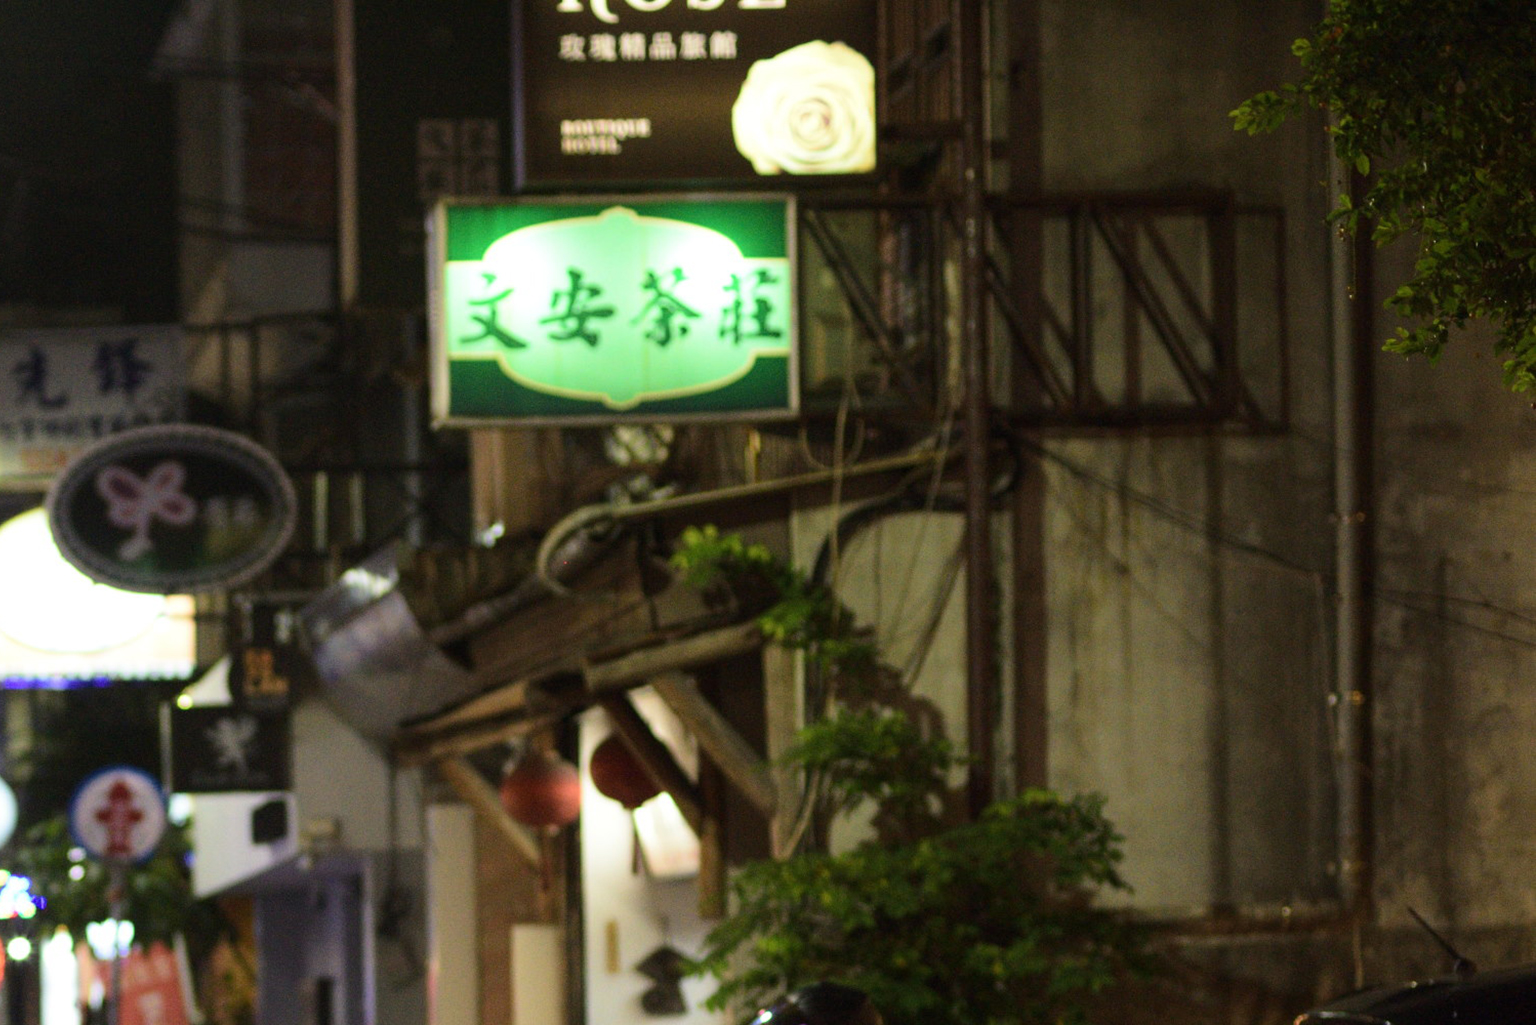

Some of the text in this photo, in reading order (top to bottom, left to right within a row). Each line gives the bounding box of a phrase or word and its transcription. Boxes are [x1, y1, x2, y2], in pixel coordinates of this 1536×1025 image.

[558, 30, 738, 62] 玫瑰精品旅館
[560, 118, 651, 140] BOUTIQUE
[560, 136, 622, 155] HOTEL
[459, 266, 784, 351] 文安茶莊
